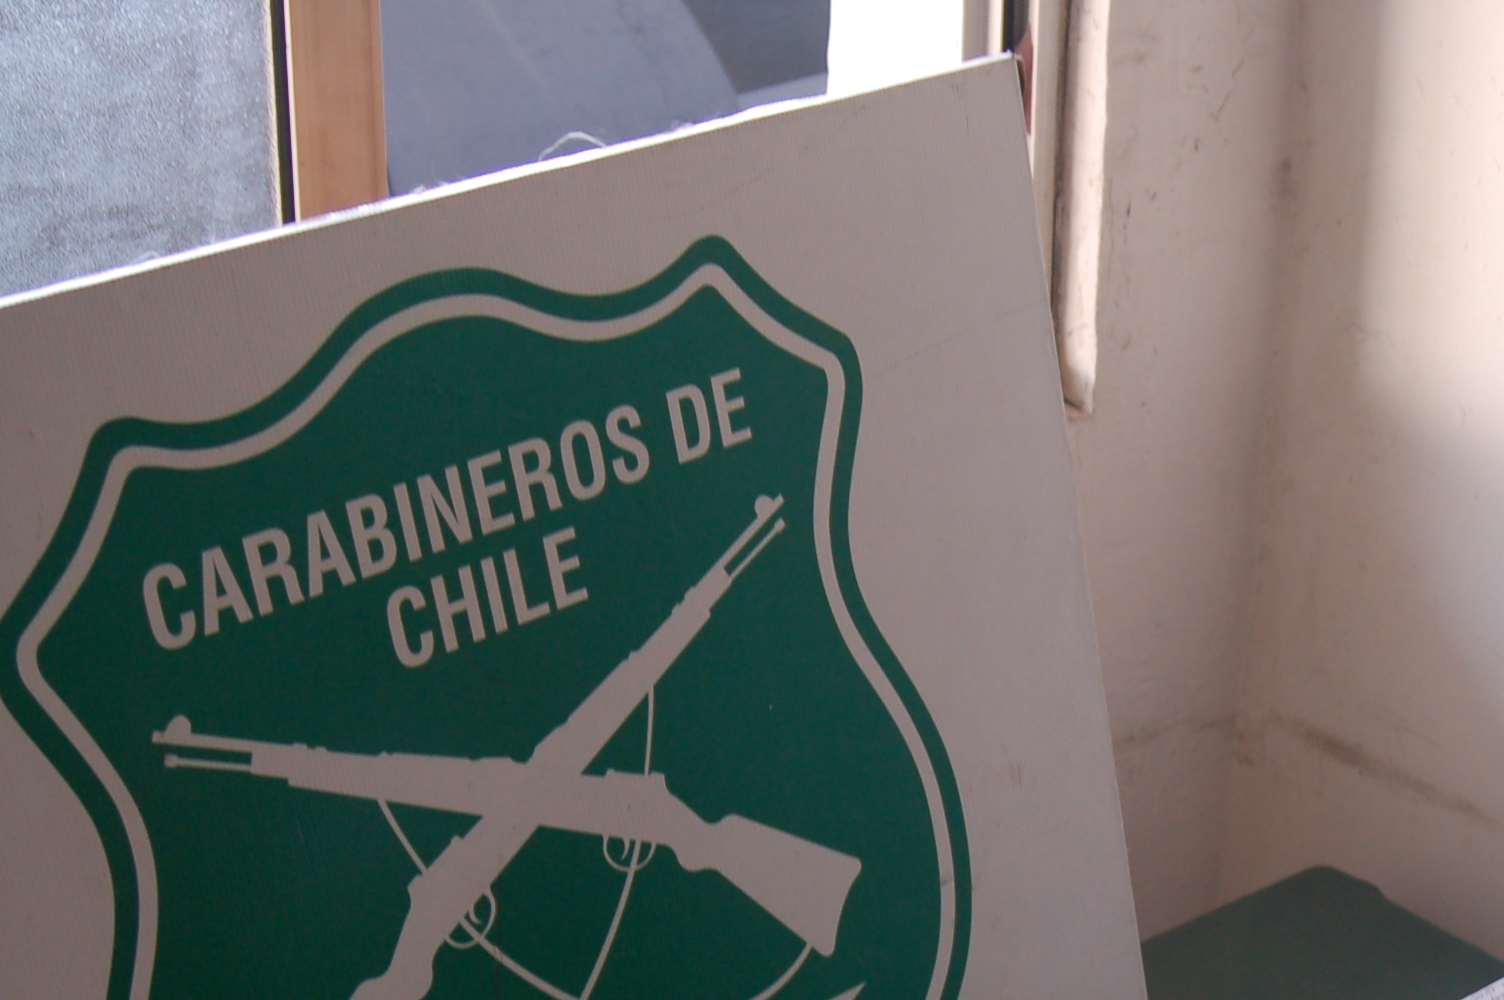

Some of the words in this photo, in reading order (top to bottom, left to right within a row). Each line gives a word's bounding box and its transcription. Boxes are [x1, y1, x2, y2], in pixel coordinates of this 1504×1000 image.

[142, 405, 650, 650] CARABINEROS
[665, 367, 752, 465] DE
[386, 527, 588, 668] CHILE
